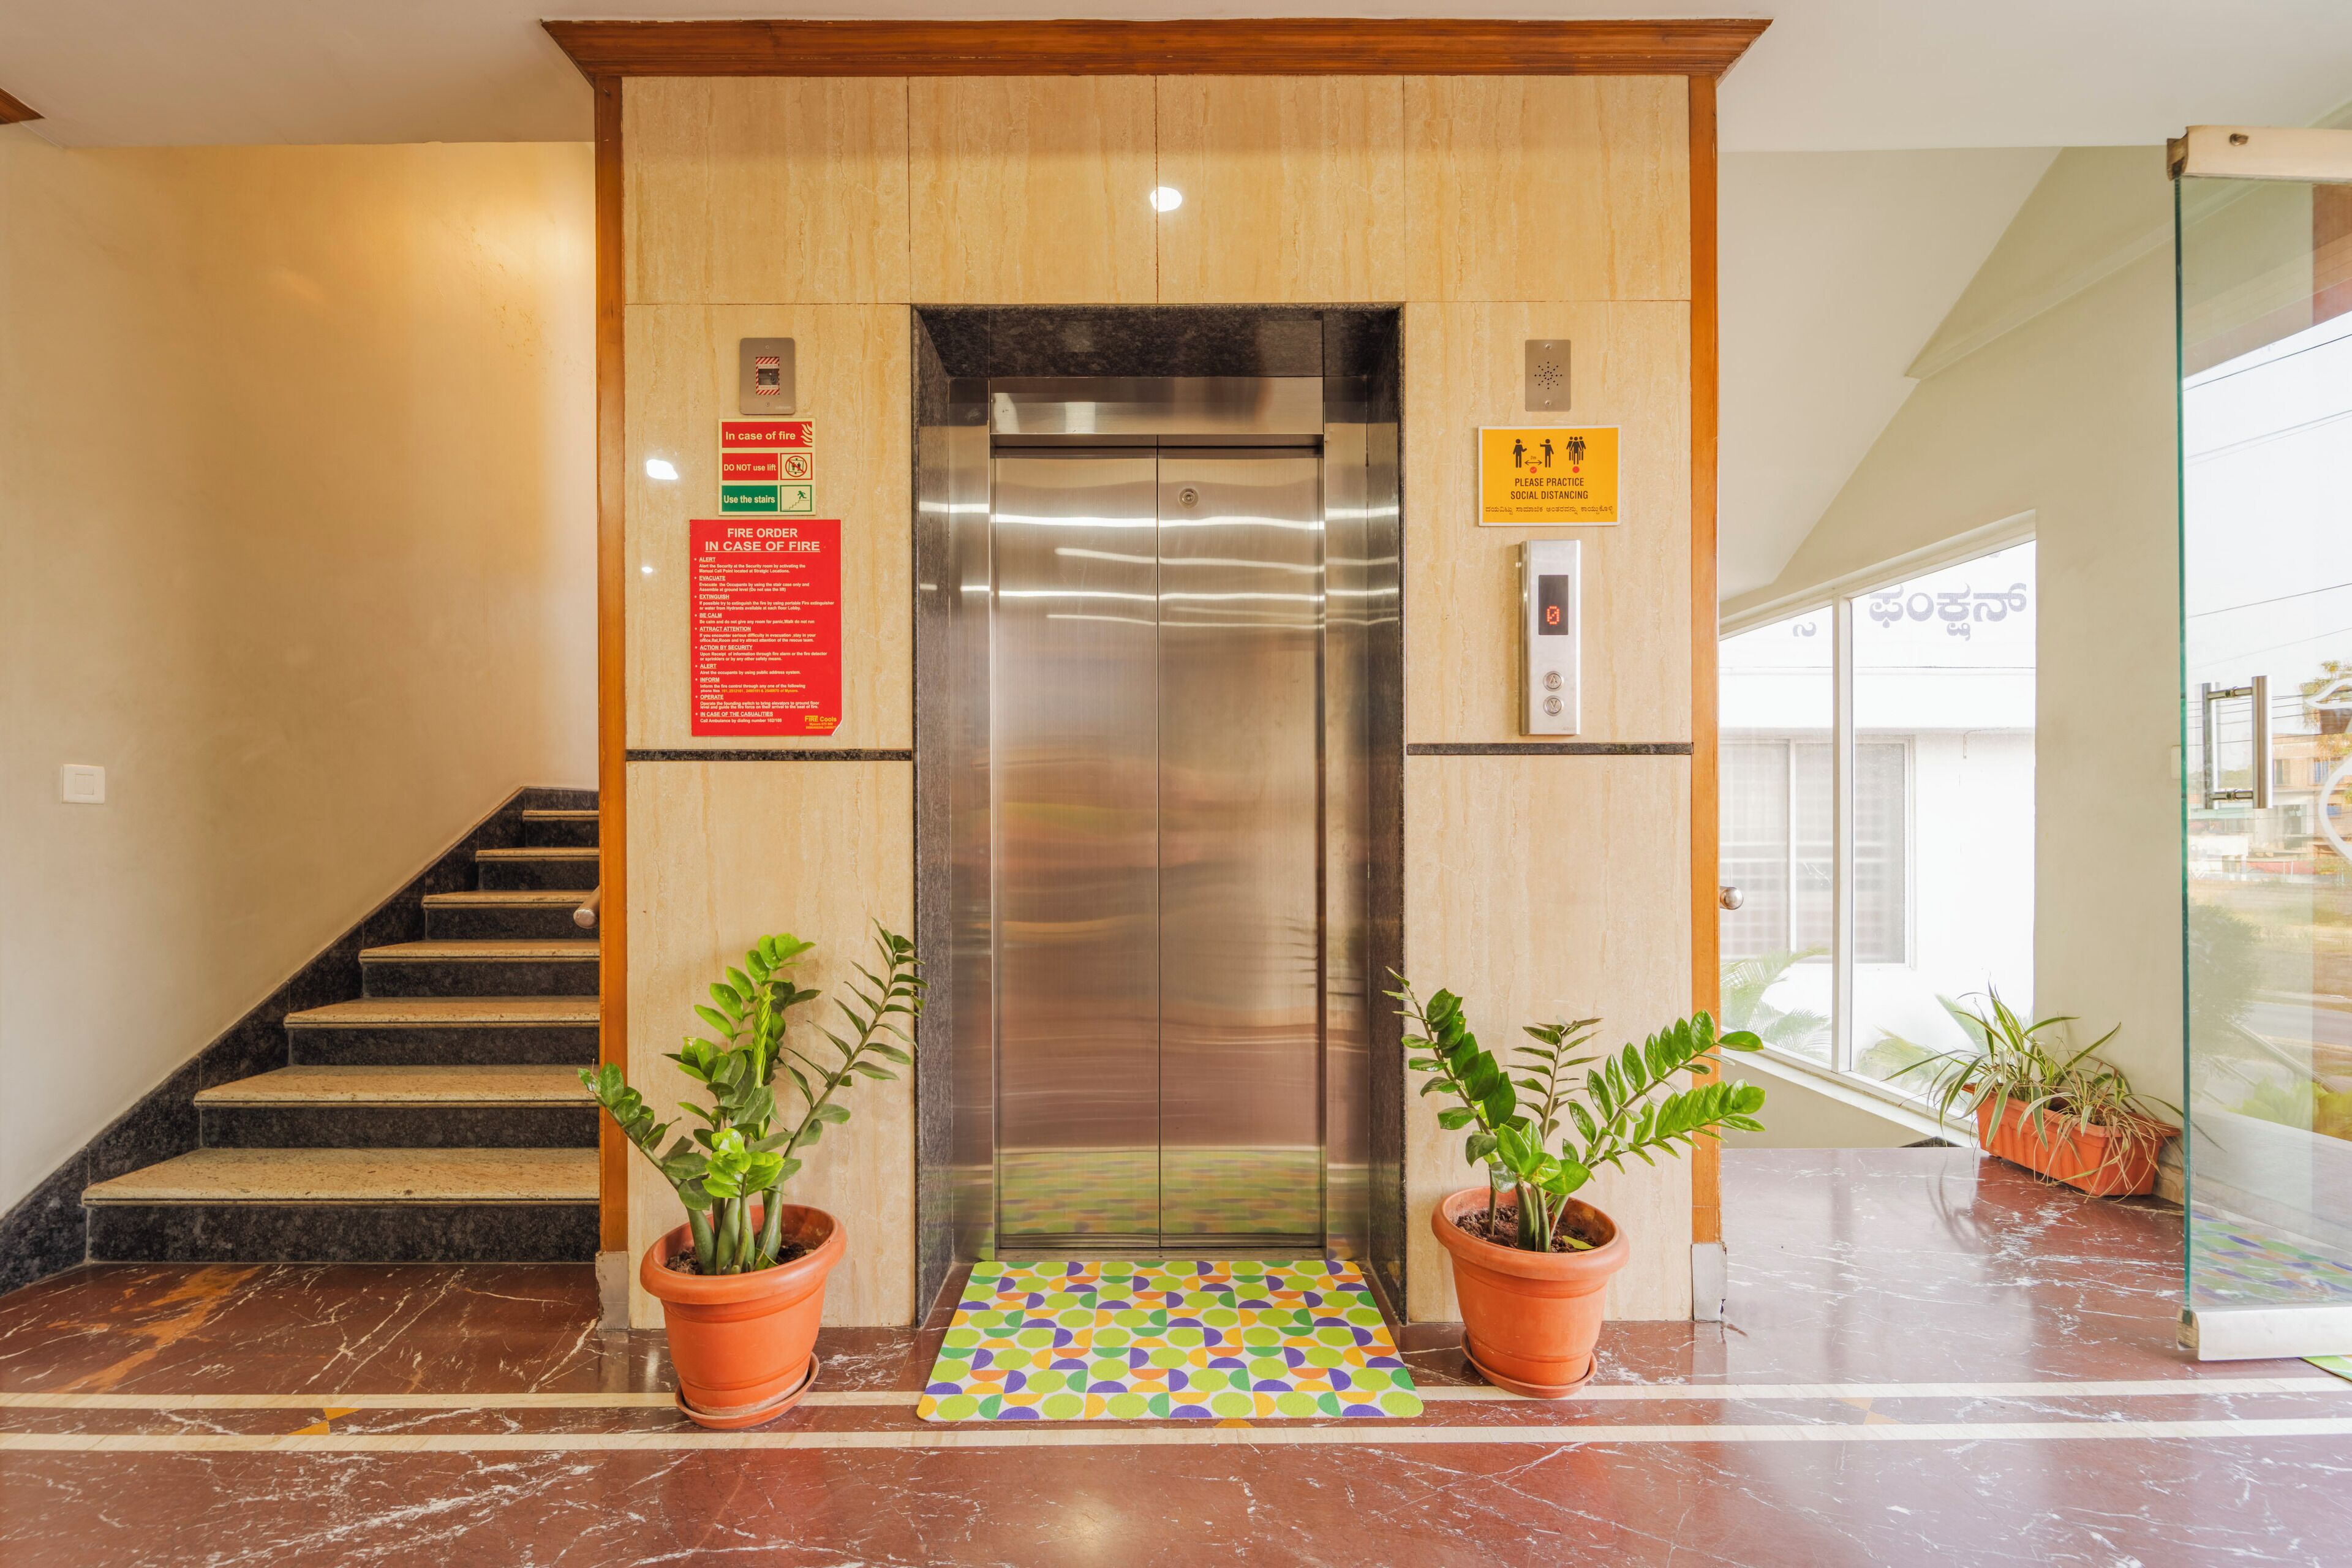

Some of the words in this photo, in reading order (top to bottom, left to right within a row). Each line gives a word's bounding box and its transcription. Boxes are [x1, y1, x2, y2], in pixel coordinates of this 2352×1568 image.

[725, 432, 735, 440] In
[766, 431, 777, 440] of
[779, 431, 796, 440] fire
[1510, 491, 1538, 500] SOCIAL
[1541, 491, 1588, 499] DISTANCING
[727, 528, 753, 538] FIRE
[756, 528, 797, 538] ORDER
[705, 541, 718, 551] IN
[723, 541, 761, 551] CASE
[766, 541, 784, 551] OF
[789, 541, 820, 551] FIRE
[1547, 606, 1559, 625] 0
